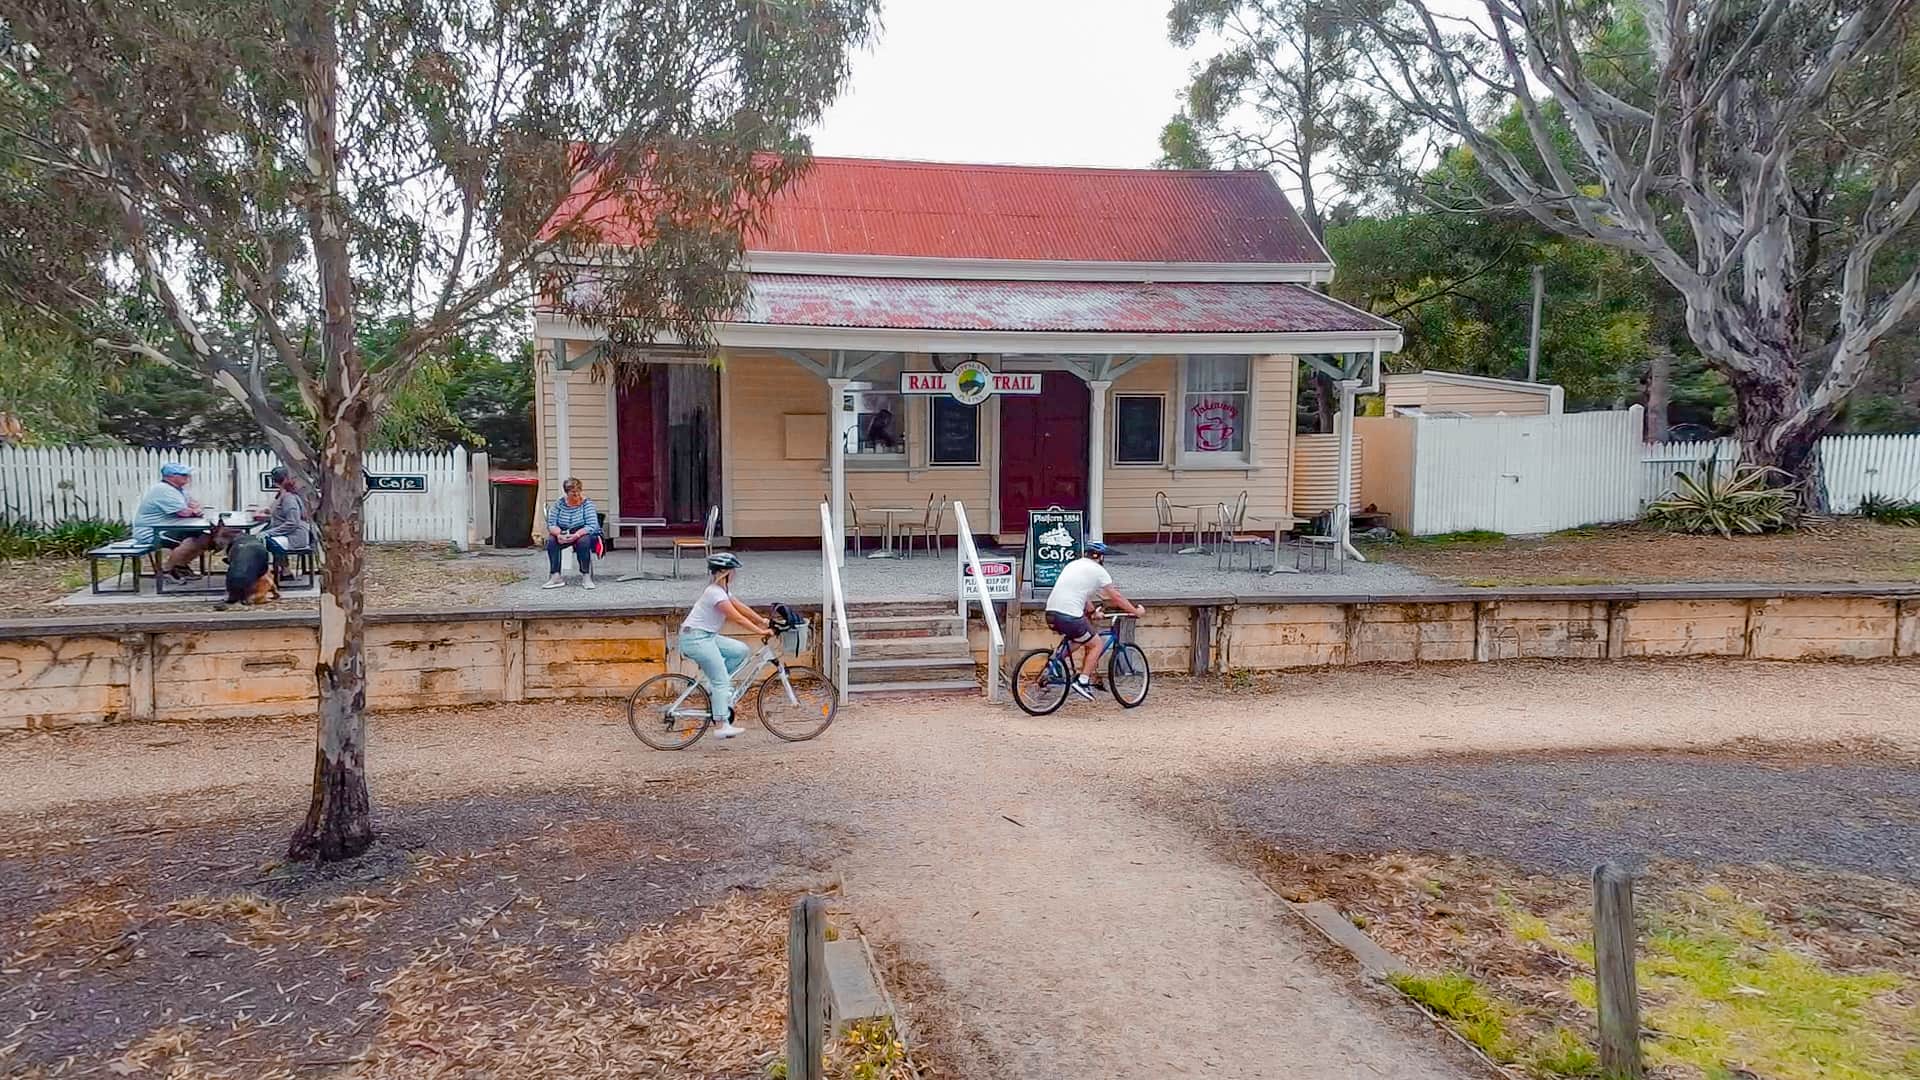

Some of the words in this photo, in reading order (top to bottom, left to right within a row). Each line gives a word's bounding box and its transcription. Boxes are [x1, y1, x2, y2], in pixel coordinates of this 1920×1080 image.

[909, 376, 946, 389] RAIL
[992, 376, 1035, 390] TRAIL
[378, 477, 417, 489] Cafe
[1038, 546, 1075, 562] Cafe
